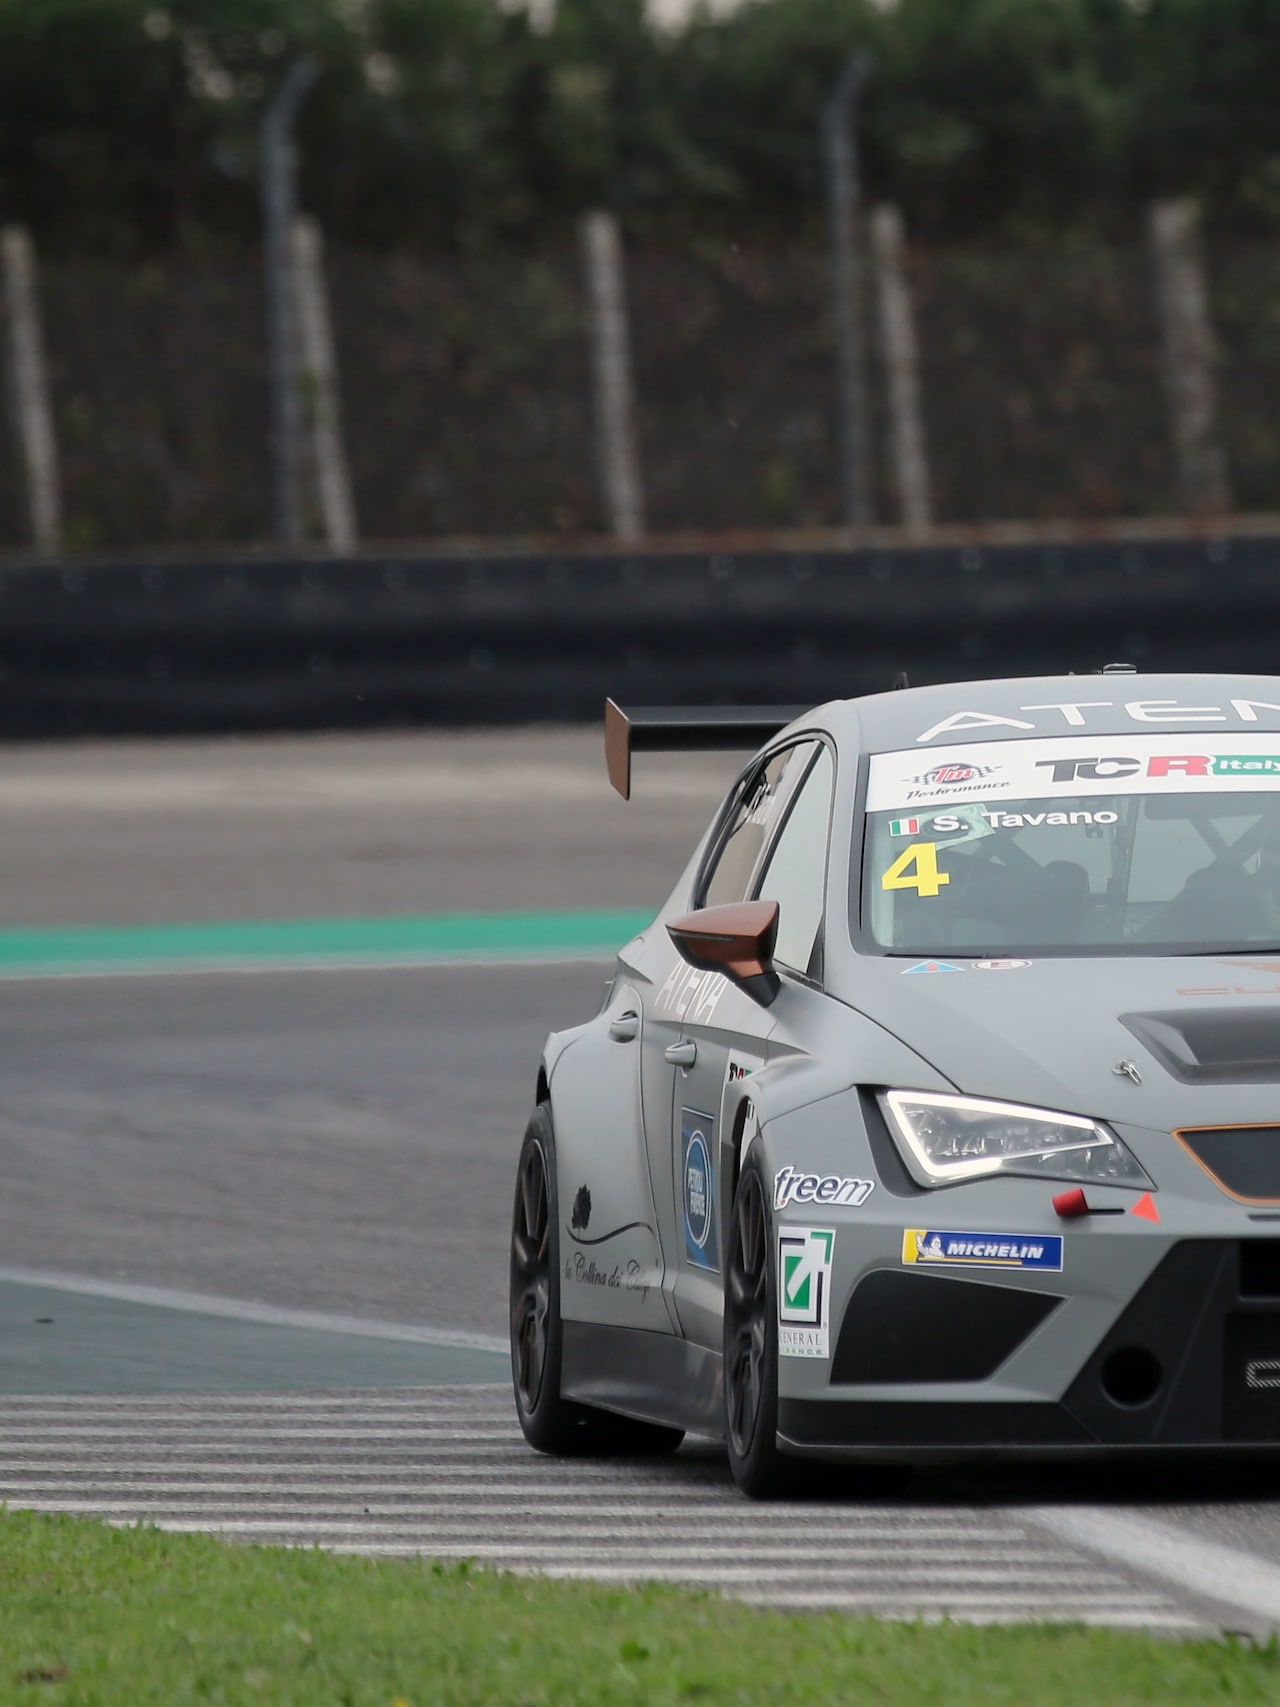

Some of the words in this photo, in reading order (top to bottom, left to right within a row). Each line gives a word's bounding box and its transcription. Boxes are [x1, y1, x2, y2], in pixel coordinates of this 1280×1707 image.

[1035, 755, 1212, 782] TCR
[906, 780, 1010, 800] Performance
[932, 814, 969, 832] S.
[981, 810, 1118, 829] Tavano
[881, 842, 950, 897] 4
[774, 1166, 875, 1210] freem
[947, 1242, 1043, 1259] MICHELIN
